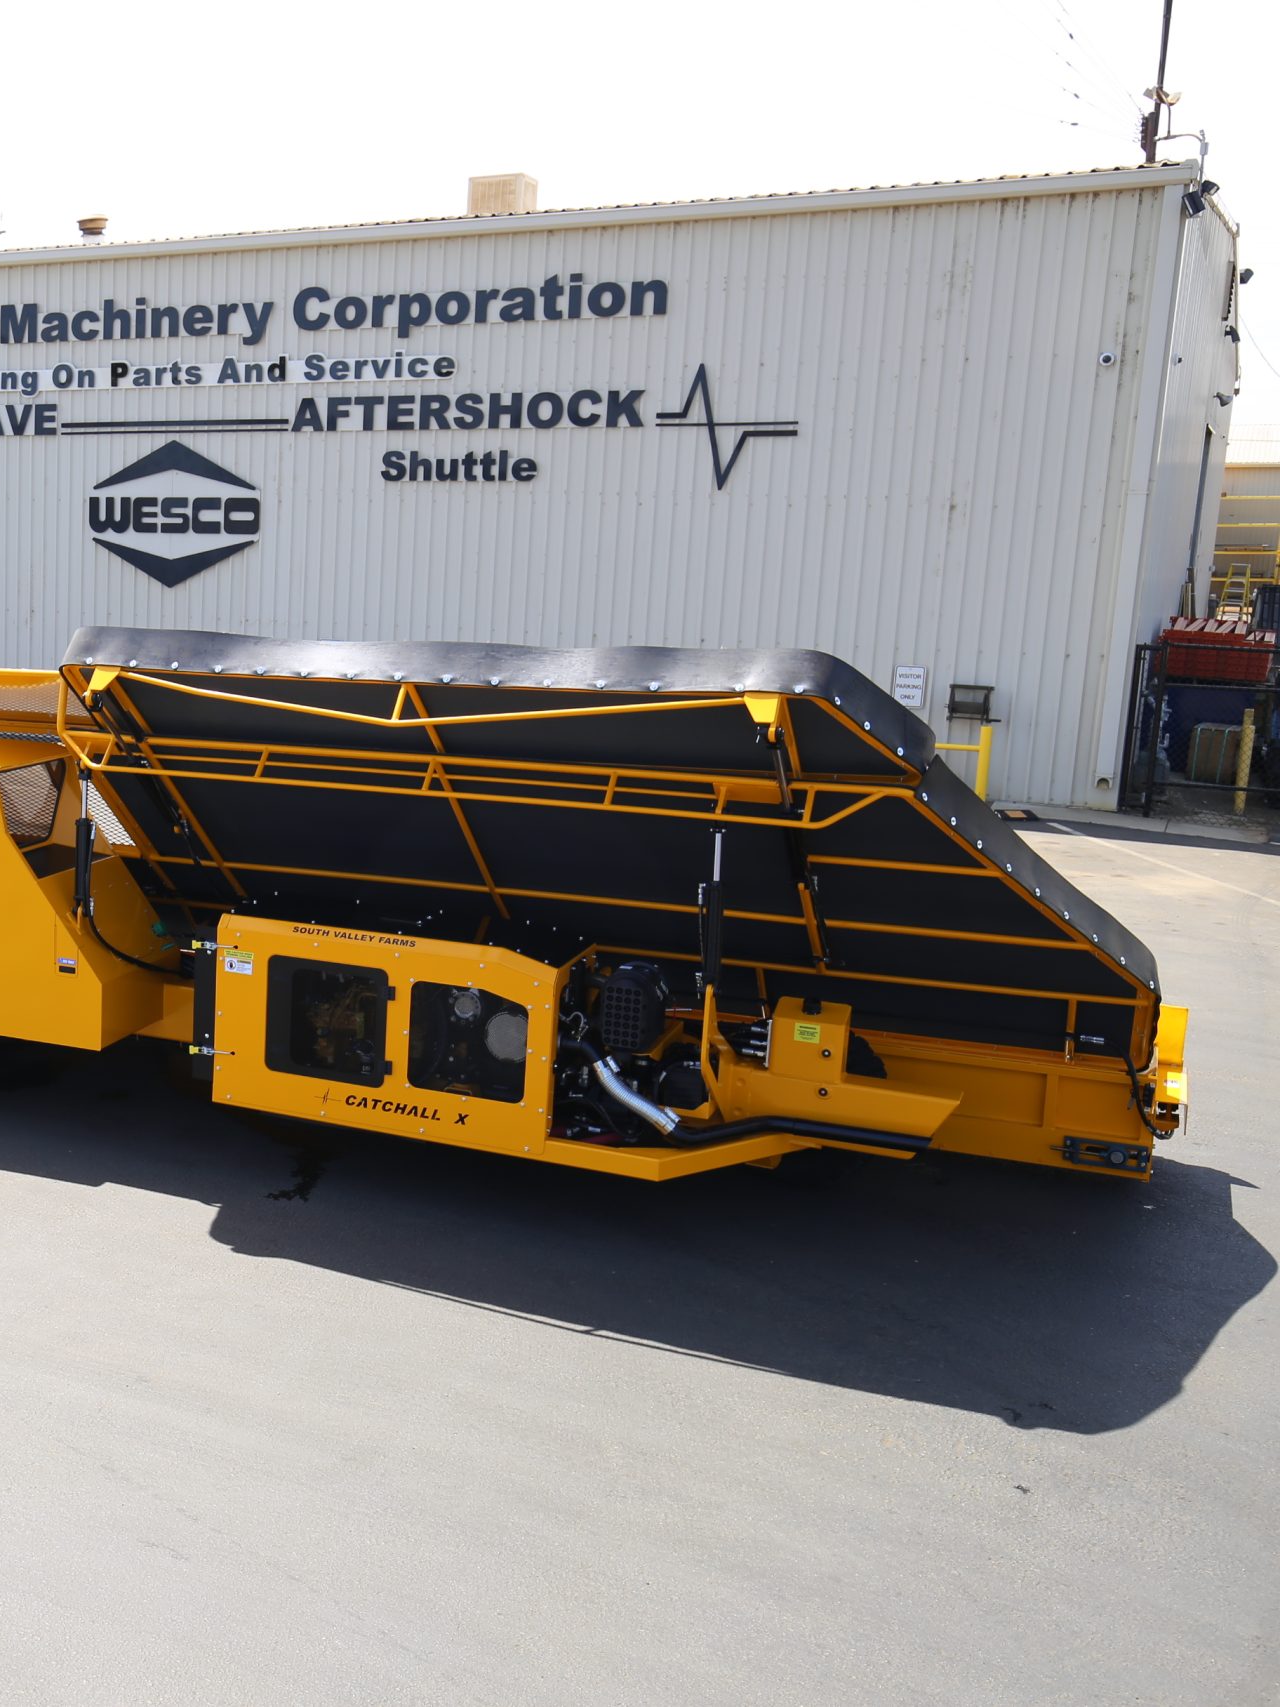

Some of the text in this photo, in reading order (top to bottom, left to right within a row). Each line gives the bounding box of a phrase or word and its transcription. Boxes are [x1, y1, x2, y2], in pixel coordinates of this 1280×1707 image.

[0, 297, 274, 345] Machinery
[293, 273, 669, 338] Corporation
[51, 363, 96, 388] On
[110, 361, 202, 387] Parts
[218, 356, 287, 384] And
[304, 350, 456, 382] Service
[291, 389, 646, 433] AFTERSHOCK
[381, 450, 538, 483] Shuttle
[88, 496, 260, 535] WESCO
[292, 926, 416, 948] SOUTH VALLEY FARMS
[345, 1094, 470, 1125] CATCHALL X
